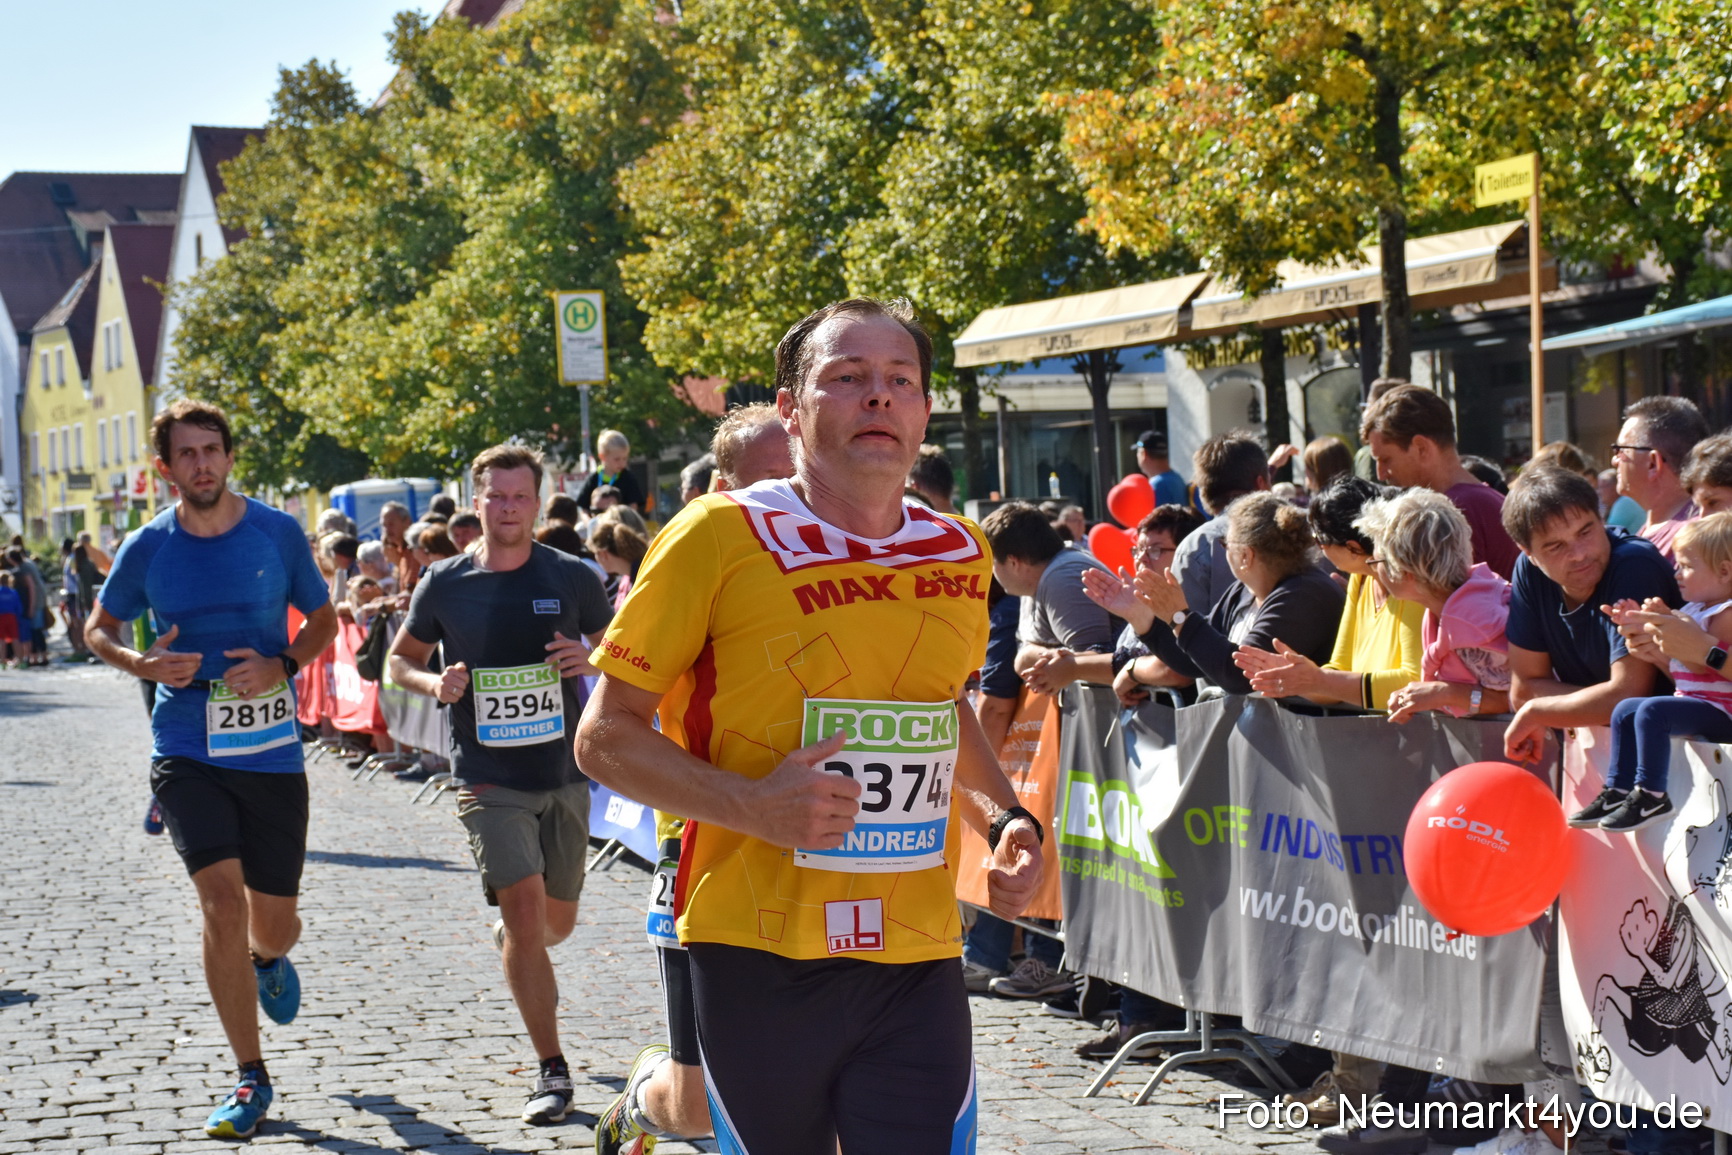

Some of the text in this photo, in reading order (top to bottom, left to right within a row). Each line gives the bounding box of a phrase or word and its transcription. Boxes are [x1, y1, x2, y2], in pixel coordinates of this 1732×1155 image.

[1487, 171, 1529, 191] Toiletten
[792, 573, 900, 616] MAX
[480, 667, 553, 690] BOCK
[219, 697, 287, 729] 2818
[485, 690, 555, 720] 2594
[489, 720, 555, 738] GÜNTHER
[820, 709, 951, 746] BOCK
[1428, 804, 1510, 846] RÖDL
[1466, 834, 1507, 853] energie
